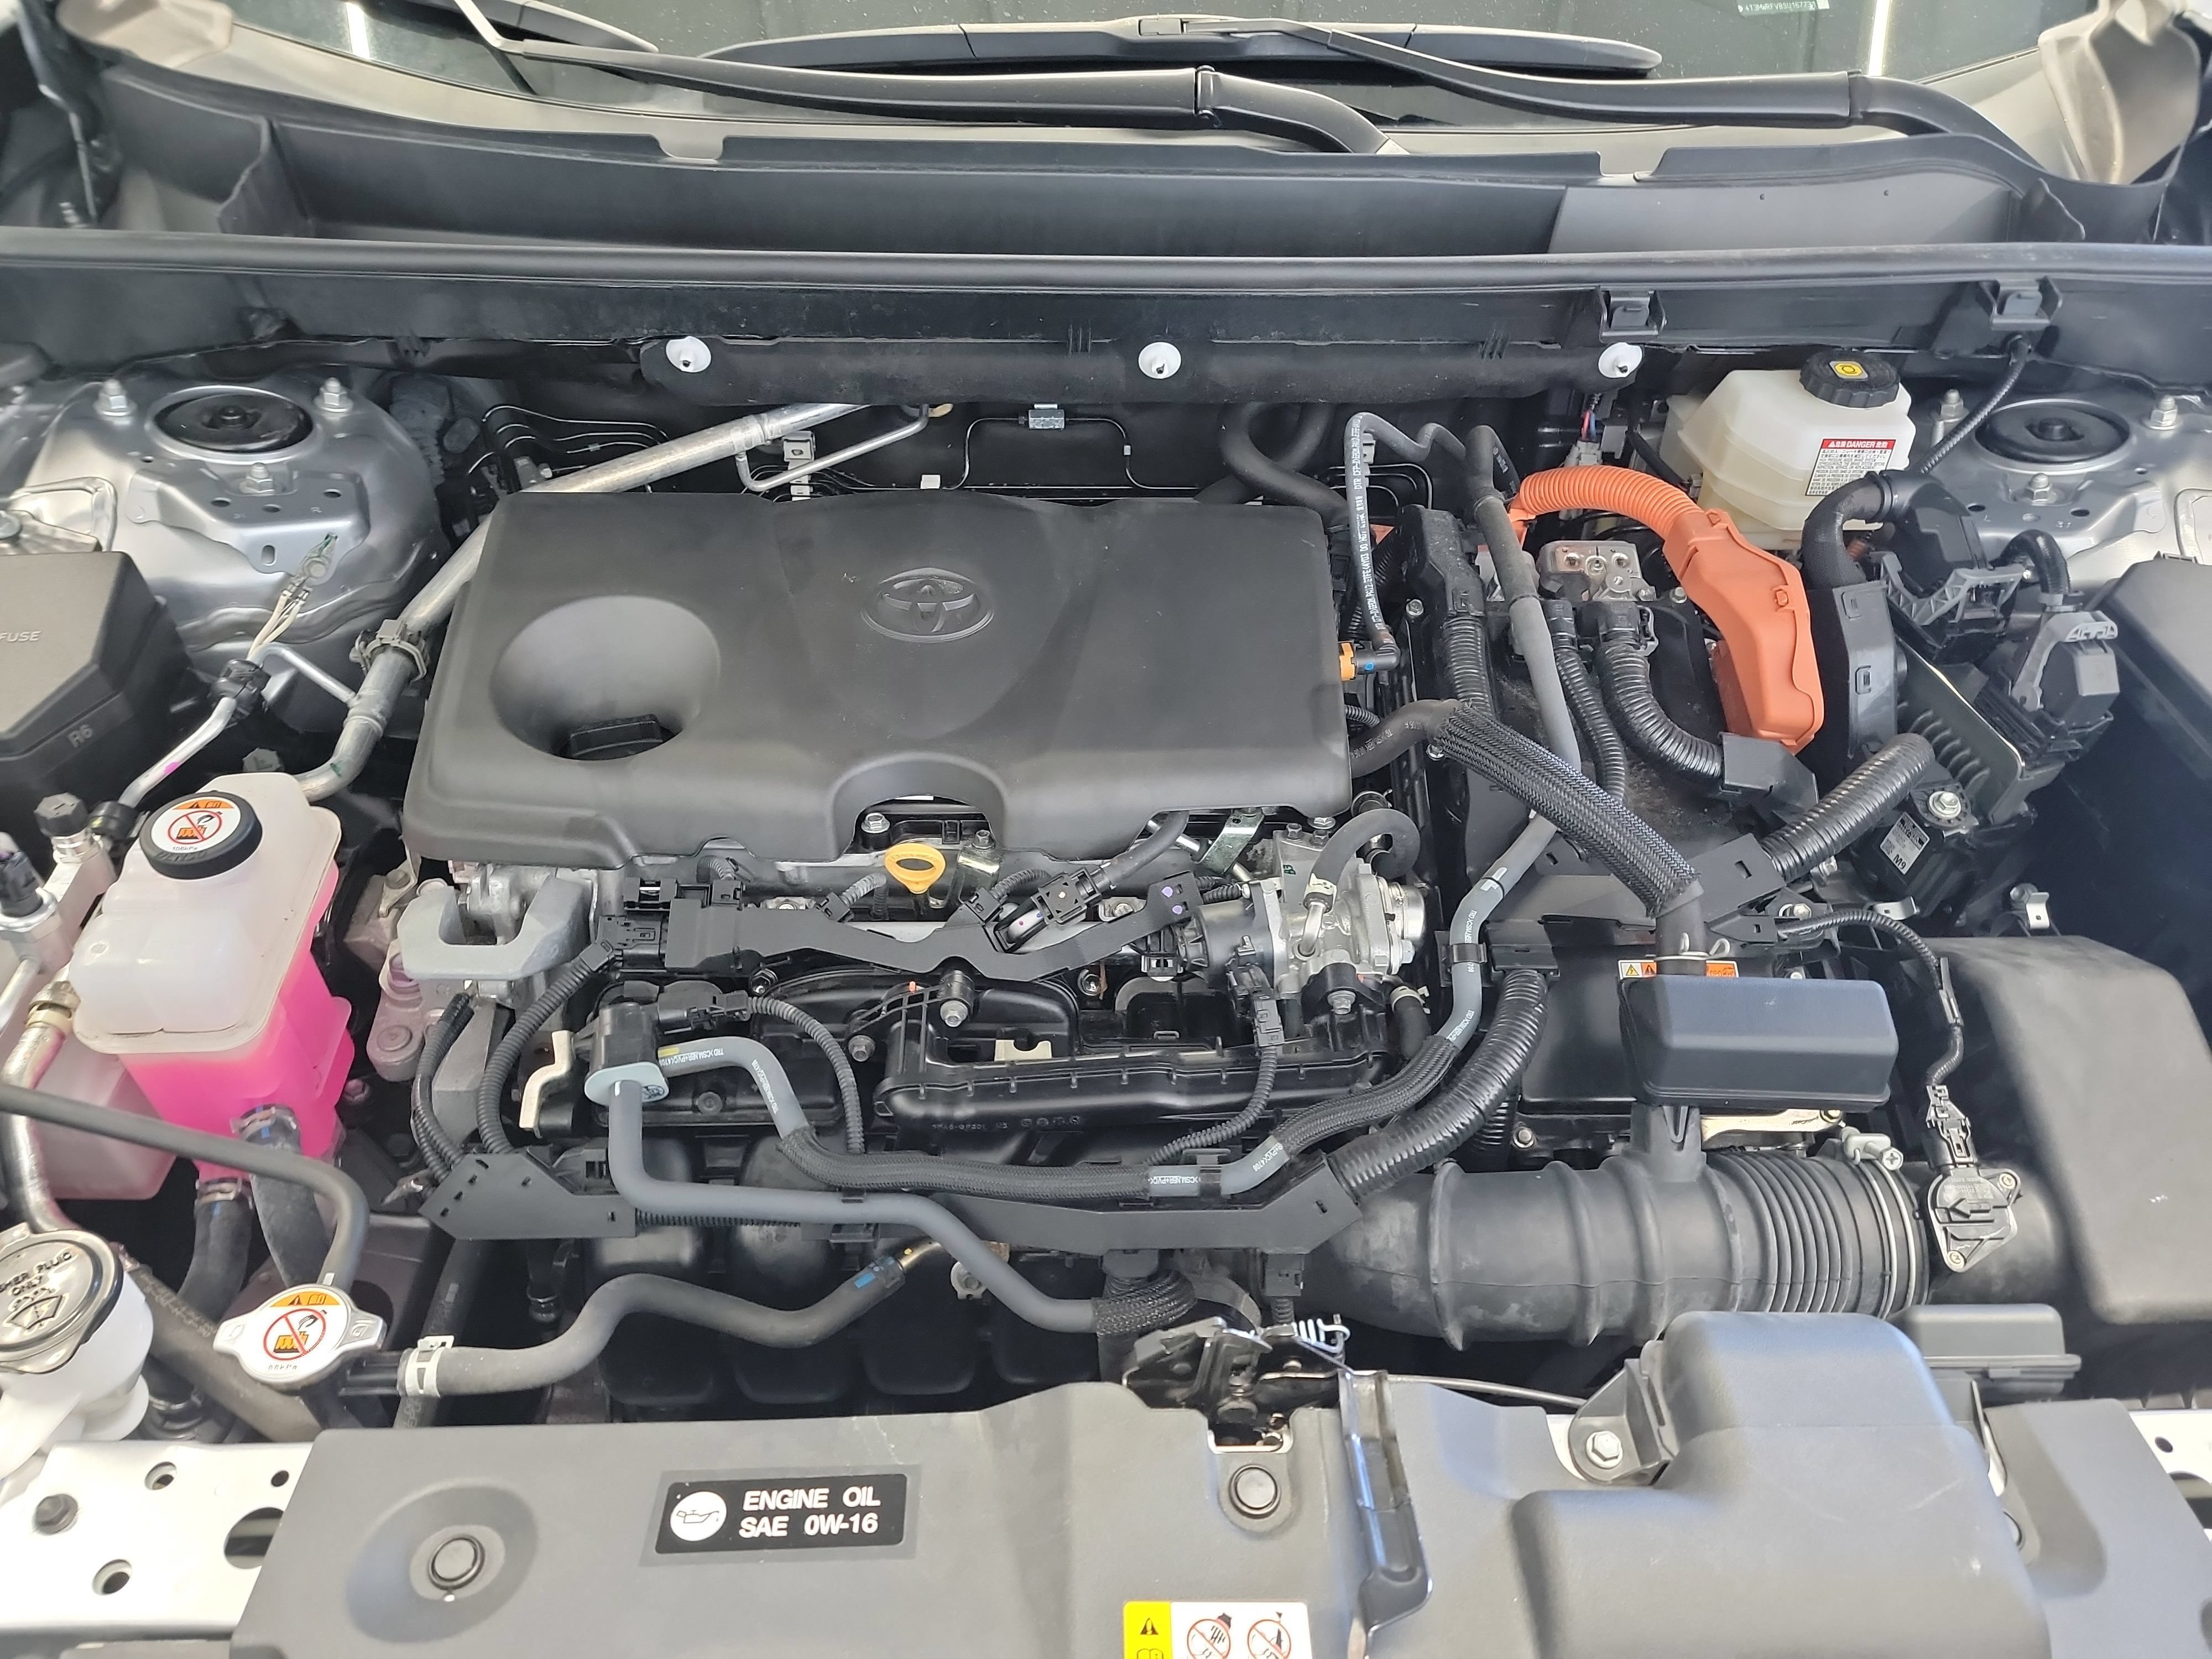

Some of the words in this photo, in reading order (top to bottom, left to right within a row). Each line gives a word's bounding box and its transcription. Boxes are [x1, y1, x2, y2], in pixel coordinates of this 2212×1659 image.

[0, 630, 41, 643] FUSE
[67, 724, 93, 748] R6
[1893, 854, 1906, 869] M9
[742, 1488, 830, 1511] ENGINE
[842, 1486, 881, 1508] OIL
[738, 1515, 790, 1538] SAE
[804, 1512, 879, 1536] 0W-16
